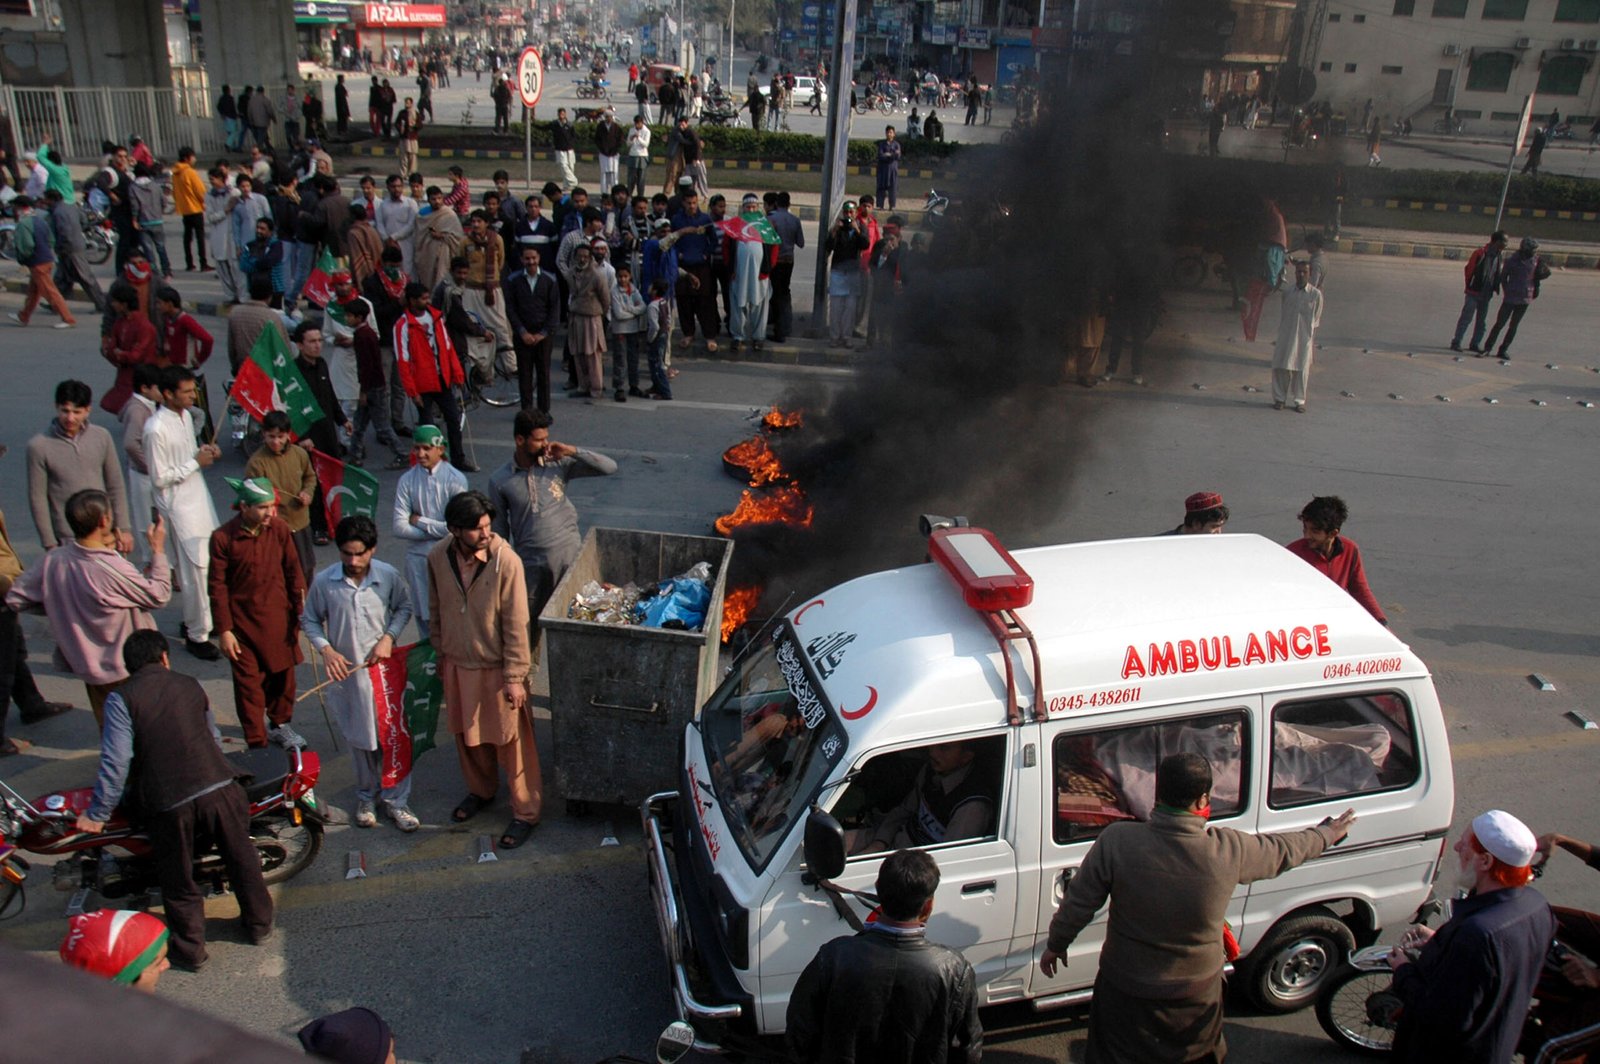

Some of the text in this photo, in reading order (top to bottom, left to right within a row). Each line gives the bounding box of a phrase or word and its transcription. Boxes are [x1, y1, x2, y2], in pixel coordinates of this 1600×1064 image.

[370, 5, 409, 23] AFZAL
[524, 72, 538, 94] 30
[1121, 623, 1332, 680] AMBULANCE
[1323, 658, 1402, 680] 0346-4020692
[1049, 687, 1142, 713] 0345-4382611
